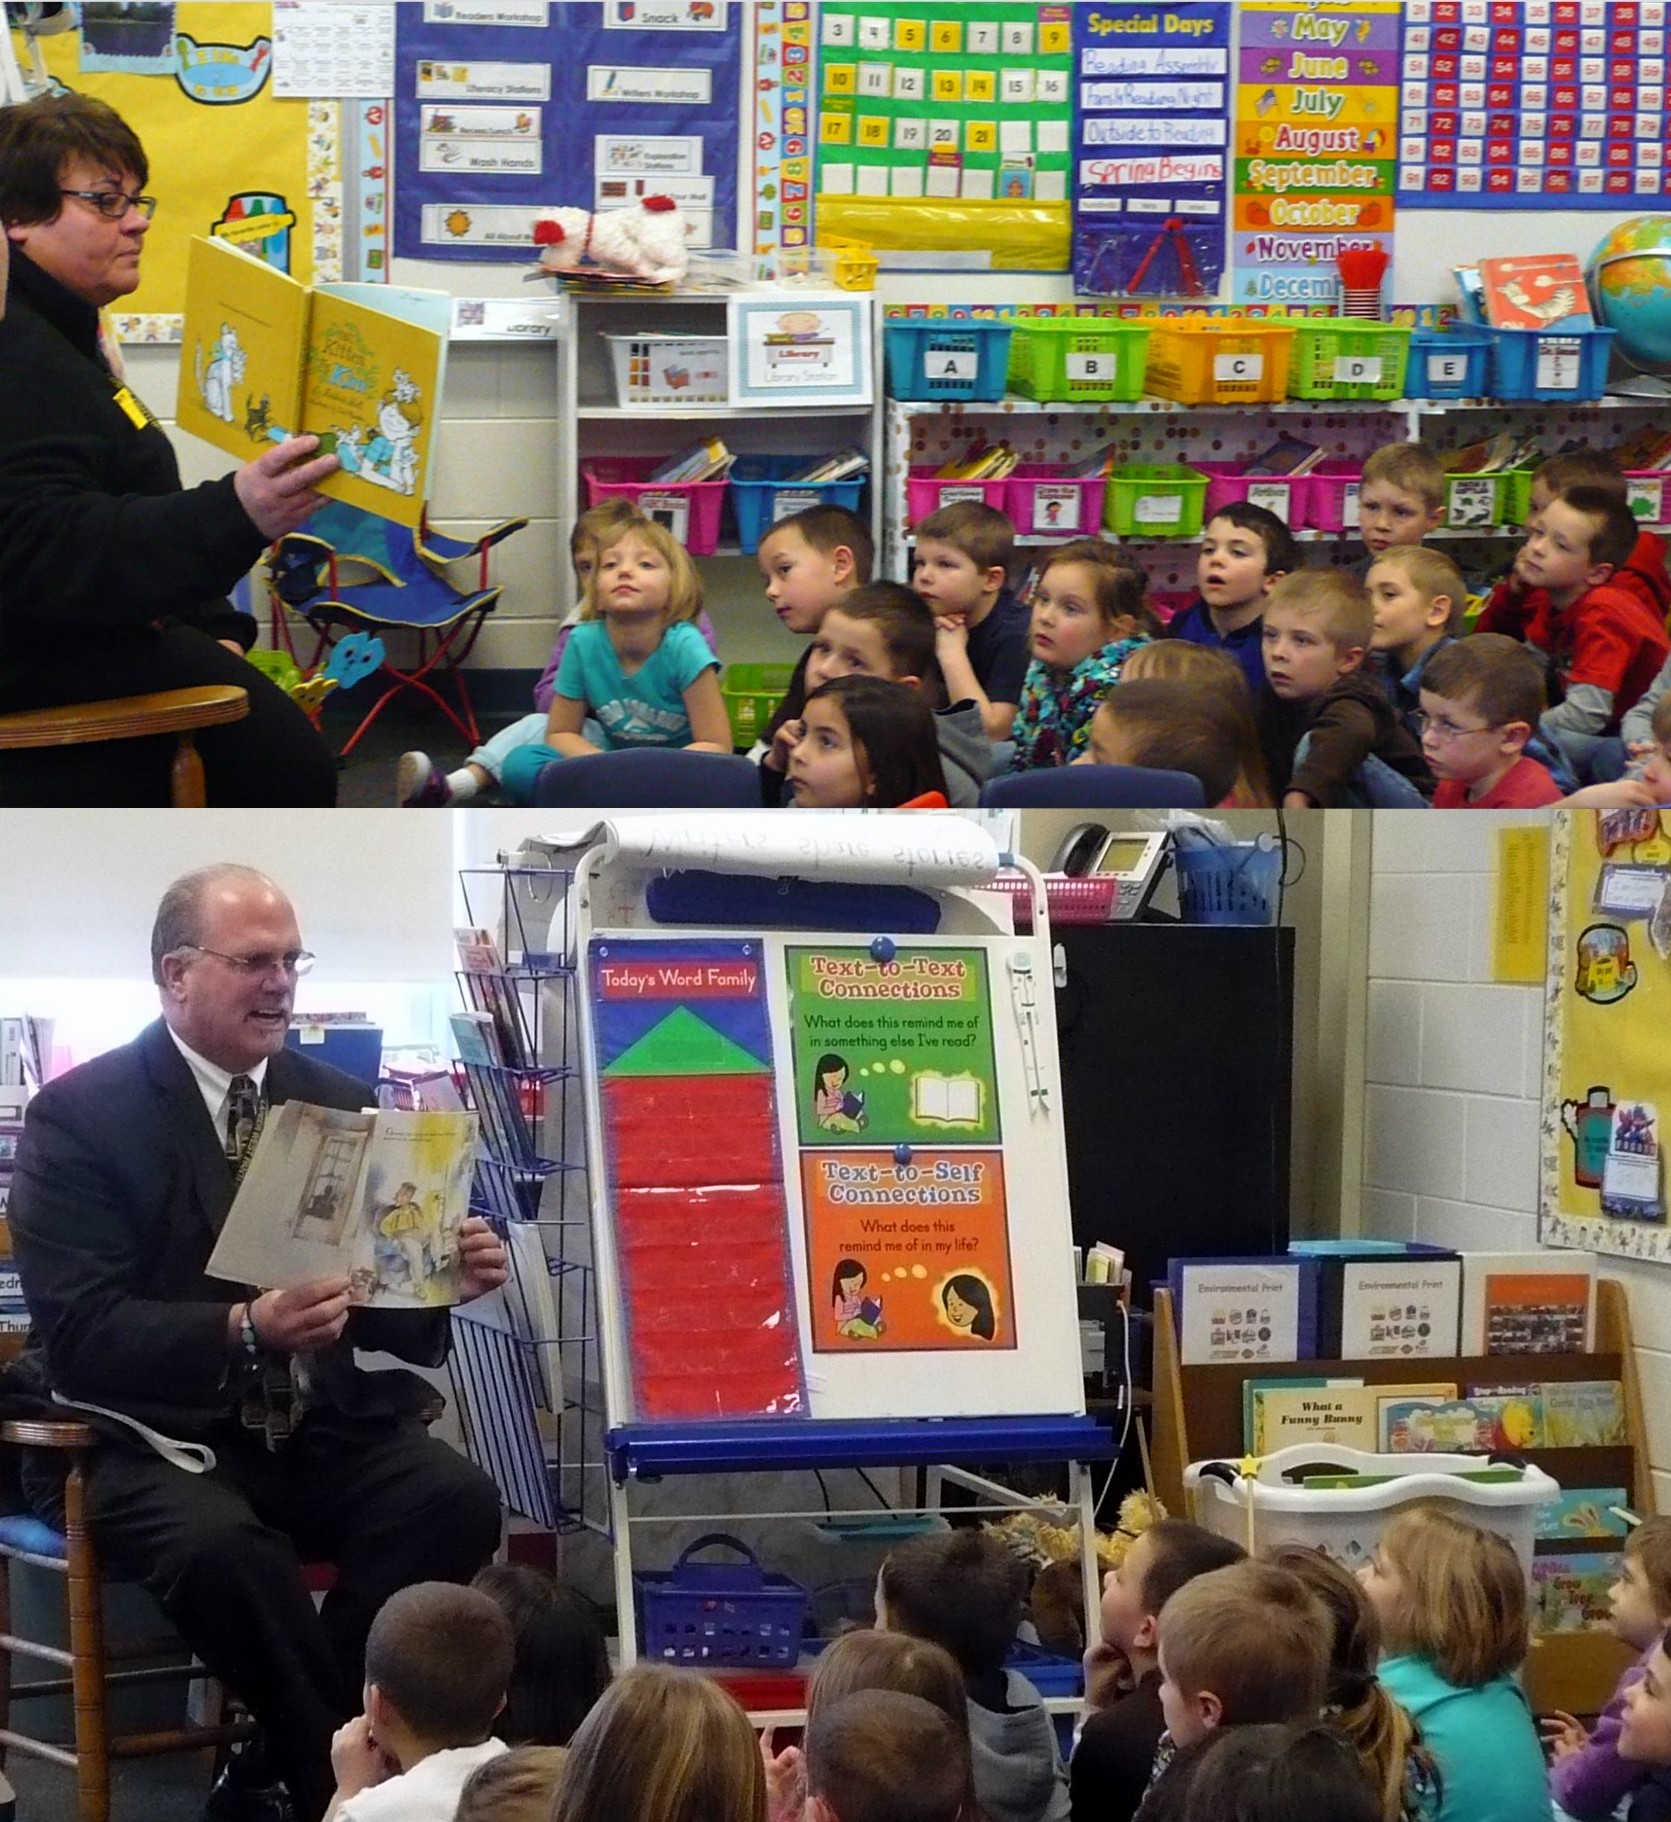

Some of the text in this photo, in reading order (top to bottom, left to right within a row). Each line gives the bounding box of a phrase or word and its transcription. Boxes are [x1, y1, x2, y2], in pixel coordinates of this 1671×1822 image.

[642, 13, 679, 24] Snack
[1088, 13, 1214, 37] Special Days
[833, 24, 842, 36] 3
[906, 29, 914, 41] 5
[941, 31, 950, 43] 6
[978, 32, 987, 43] 7
[1012, 32, 1021, 44] 8
[1050, 32, 1059, 44] 9
[1291, 13, 1350, 47] May
[1288, 52, 1349, 79] June
[832, 73, 1058, 92] 10 11 12 13 14 15 16
[1290, 87, 1345, 120] July
[827, 122, 988, 143] 17 18 19 20 21
[1274, 124, 1360, 156] August
[501, 159, 535, 168] Hands
[1088, 155, 1222, 184] Spring Begins
[1248, 159, 1376, 193] September
[1269, 198, 1360, 226] October
[1259, 271, 1342, 299] Decem
[1439, 309, 1451, 326] 2
[779, 350, 820, 359] Library
[943, 360, 957, 374] A
[1086, 360, 1098, 373] B
[1233, 360, 1245, 374] C
[1351, 363, 1363, 376] D
[1444, 362, 1454, 375] E
[764, 372, 799, 384] Library
[811, 956, 966, 978] Text-to-Text
[601, 968, 756, 993] Today's Word Family
[819, 979, 961, 999] Connections
[804, 1015, 980, 1028] What does this remind me of
[810, 1033, 977, 1050] in something else I've read?
[823, 1162, 984, 1183] Text-to-Self
[829, 1184, 981, 1204] Connections
[860, 1219, 955, 1233] What does this
[839, 1237, 980, 1255] remind me of in my life?
[1198, 1283, 1284, 1294] Environmental Print
[1358, 1280, 1443, 1291] Environmental Print
[1302, 1402, 1343, 1411] What a
[1281, 1414, 1363, 1426] Funny Bunny
